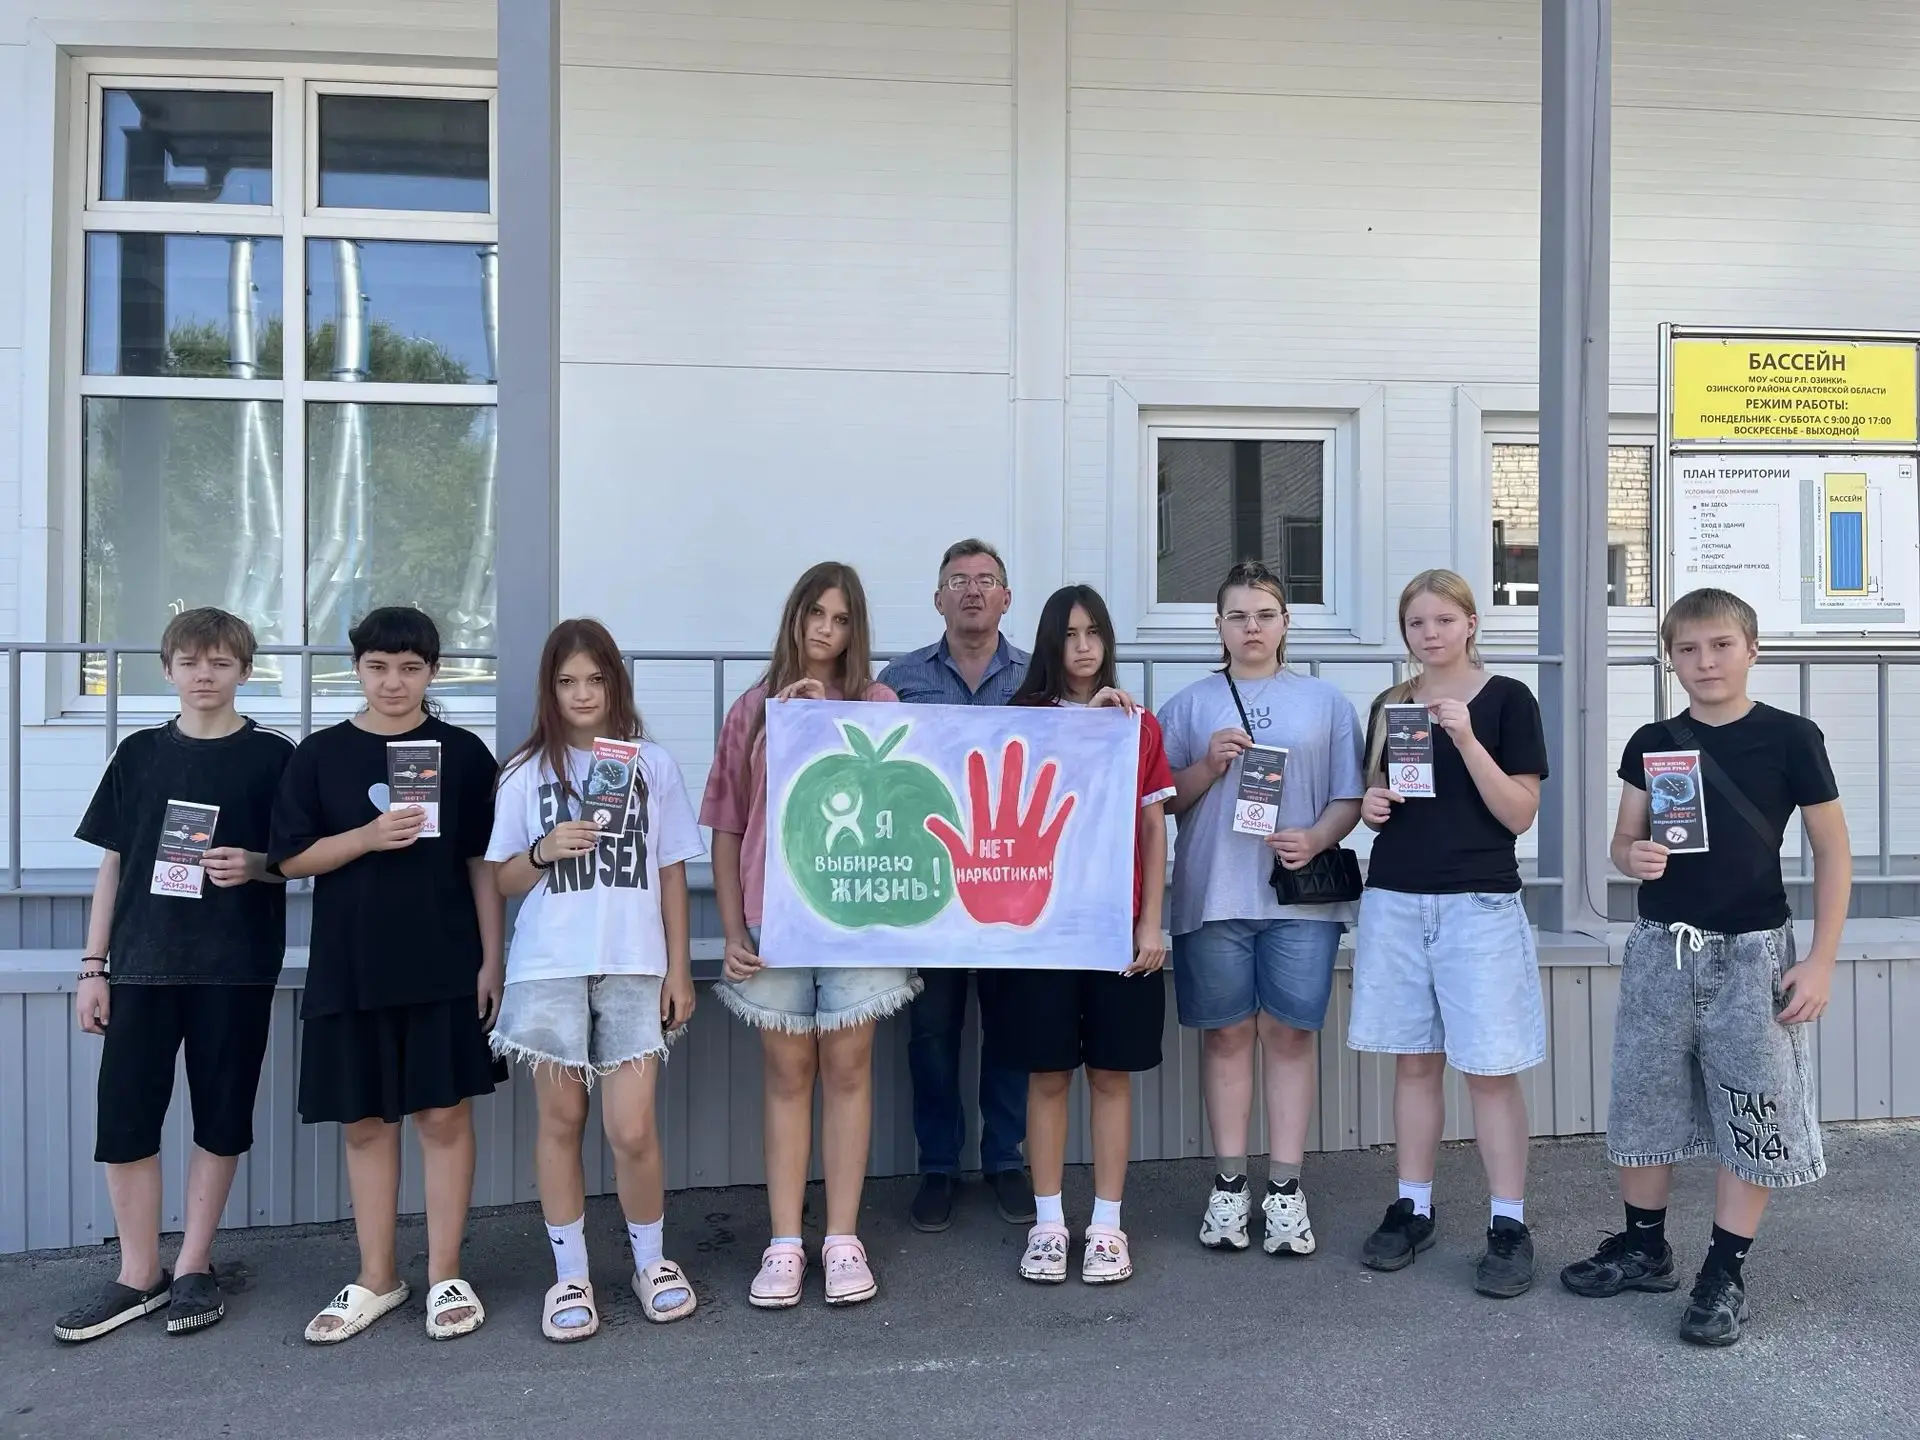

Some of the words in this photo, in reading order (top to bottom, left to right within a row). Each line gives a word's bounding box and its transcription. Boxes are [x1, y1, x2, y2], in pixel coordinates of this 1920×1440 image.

[1749, 350, 1846, 371] БАССЕЙН
[1748, 376, 1767, 384] МОУ
[1769, 376, 1793, 384] «СОШ
[1794, 376, 1809, 384] Р.П.
[1706, 385, 1755, 394] ОЗИНСКОГО
[1757, 384, 1791, 394] РАЙОНА
[1792, 385, 1849, 395] САРАТОВСКОЙ
[1850, 387, 1887, 395] ОБЛАСТИ
[1746, 399, 1793, 410] РЕЖИМ
[1795, 399, 1849, 411] РАБОТЫ:
[1700, 414, 1772, 424] ПОНЕДЕЛЬНИК
[1779, 415, 1822, 424] СУББОТА
[1823, 416, 1831, 424] С
[1831, 416, 1850, 425] 9:00
[1851, 416, 1867, 426] ДО
[1868, 416, 1891, 426] 17:00
[1734, 426, 1798, 436] ВОСКРЕСЕНЬЕ
[1805, 425, 1860, 436] ВЫХОДНОЙ
[1683, 469, 1716, 479] ПЛАН
[1718, 469, 1791, 479] ТЕРРИТОРИИ
[1829, 494, 1863, 503] БАССЕЙН
[875, 810, 892, 839] Я
[979, 838, 1016, 859] НЕТ
[599, 830, 649, 890] SEX
[956, 860, 1054, 885] НАРКОТИКАМ!
[653, 1274, 679, 1287] PUMA
[434, 1295, 468, 1308] adidas
[556, 1292, 582, 1305] PUMA
